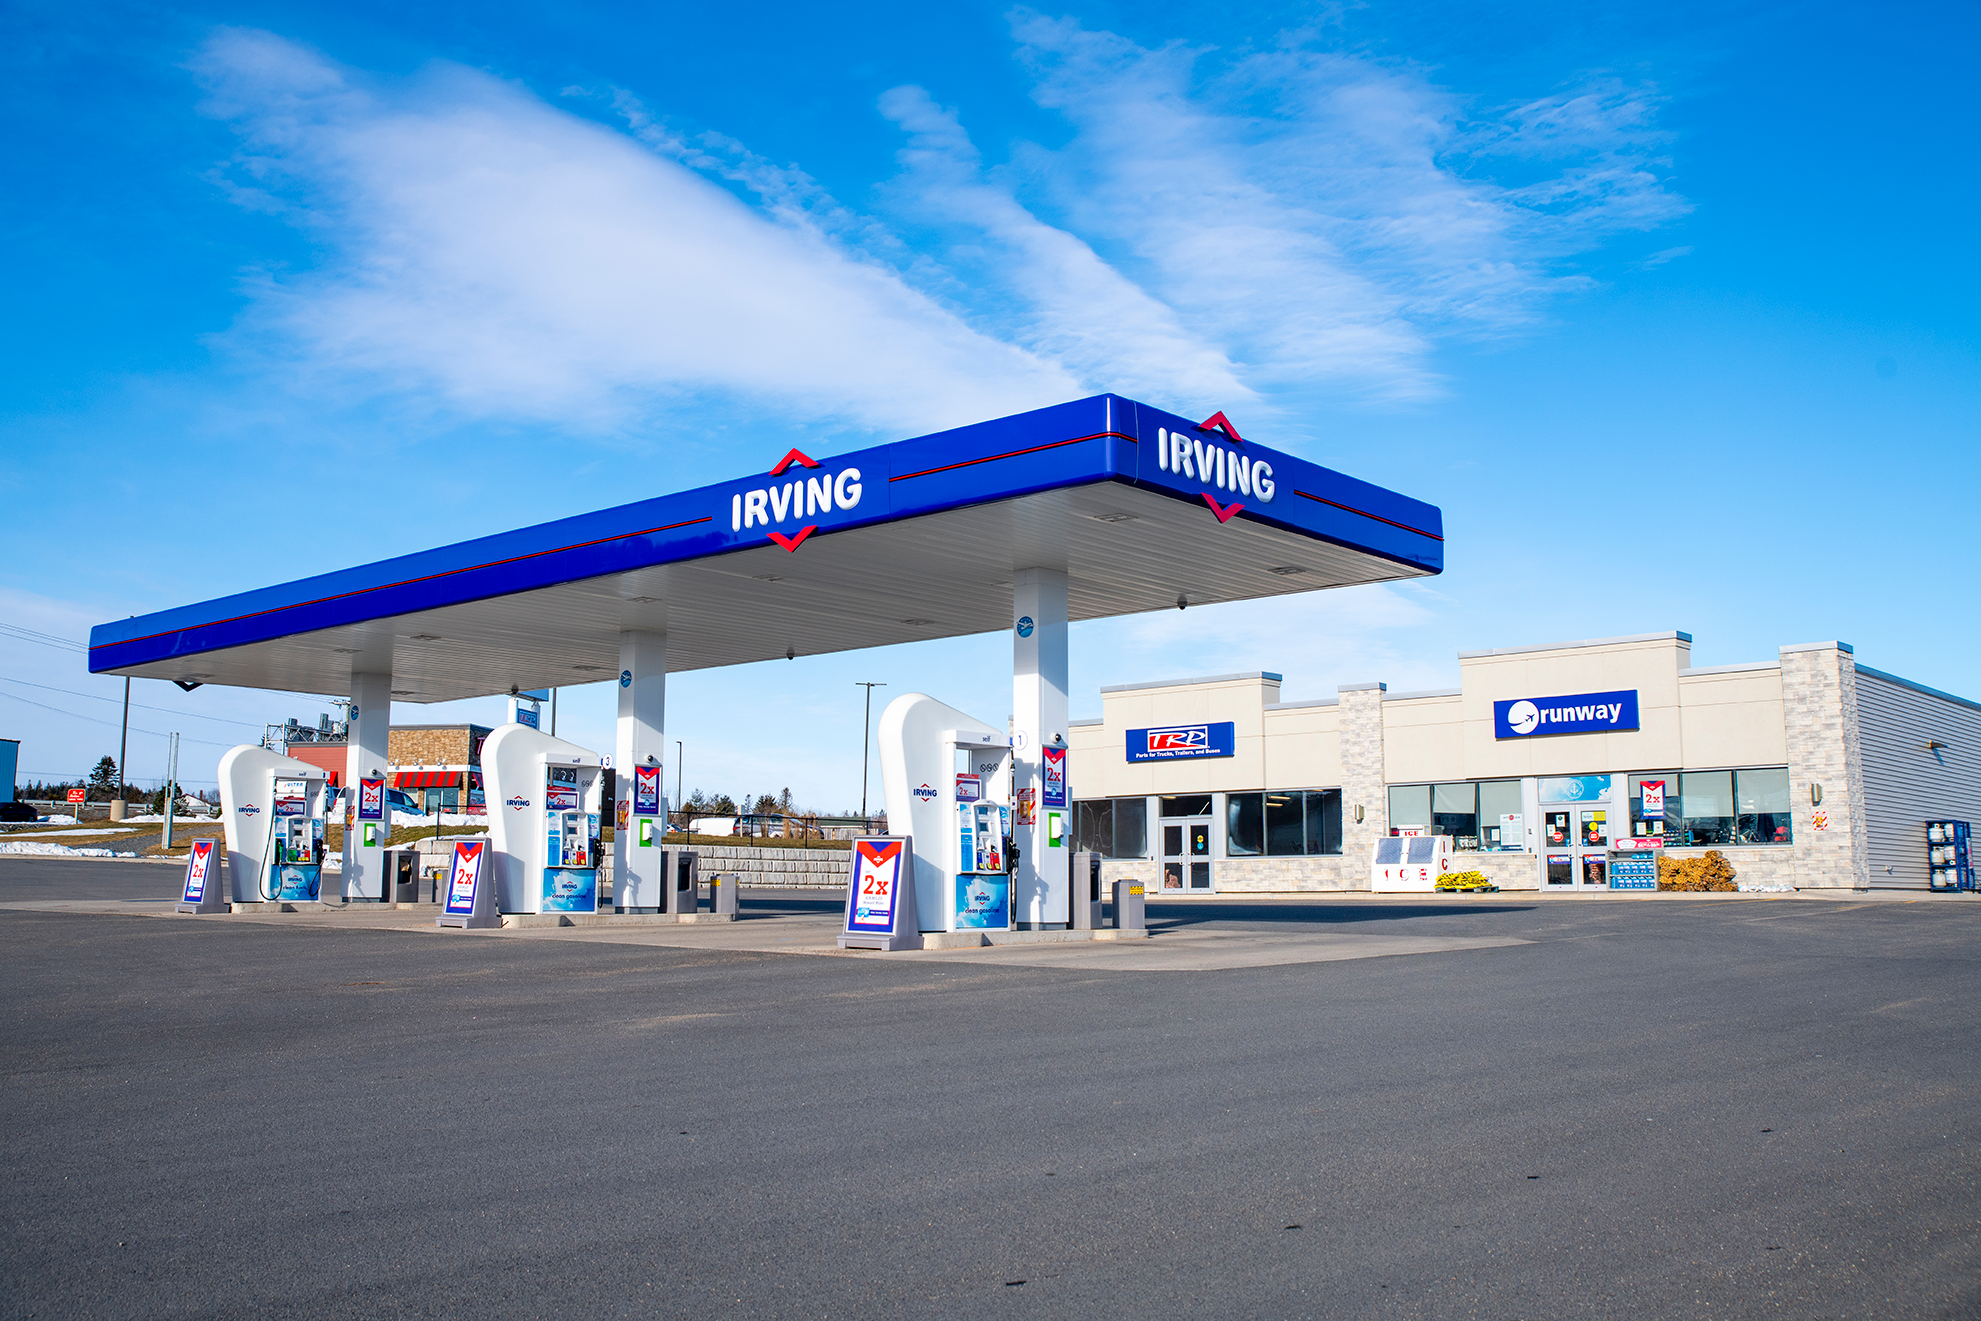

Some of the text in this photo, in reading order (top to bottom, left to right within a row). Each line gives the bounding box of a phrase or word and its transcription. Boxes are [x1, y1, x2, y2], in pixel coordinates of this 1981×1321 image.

[1158, 427, 1275, 503] IRVING
[732, 467, 862, 532] IRVING
[1540, 703, 1622, 724] runway
[1149, 731, 1206, 748] TRP
[1047, 767, 1061, 782] 2x
[640, 782, 655, 794] 2x
[913, 788, 937, 797] IRVING
[959, 787, 968, 796] 2x
[365, 792, 379, 803] 2x
[506, 799, 530, 807] IRVING
[556, 797, 566, 805] 2x
[1645, 794, 1660, 803] 2x
[193, 864, 204, 878] 2x
[456, 868, 473, 885] 2x
[1384, 868, 1428, 881] ICE
[863, 875, 889, 895] 2x
